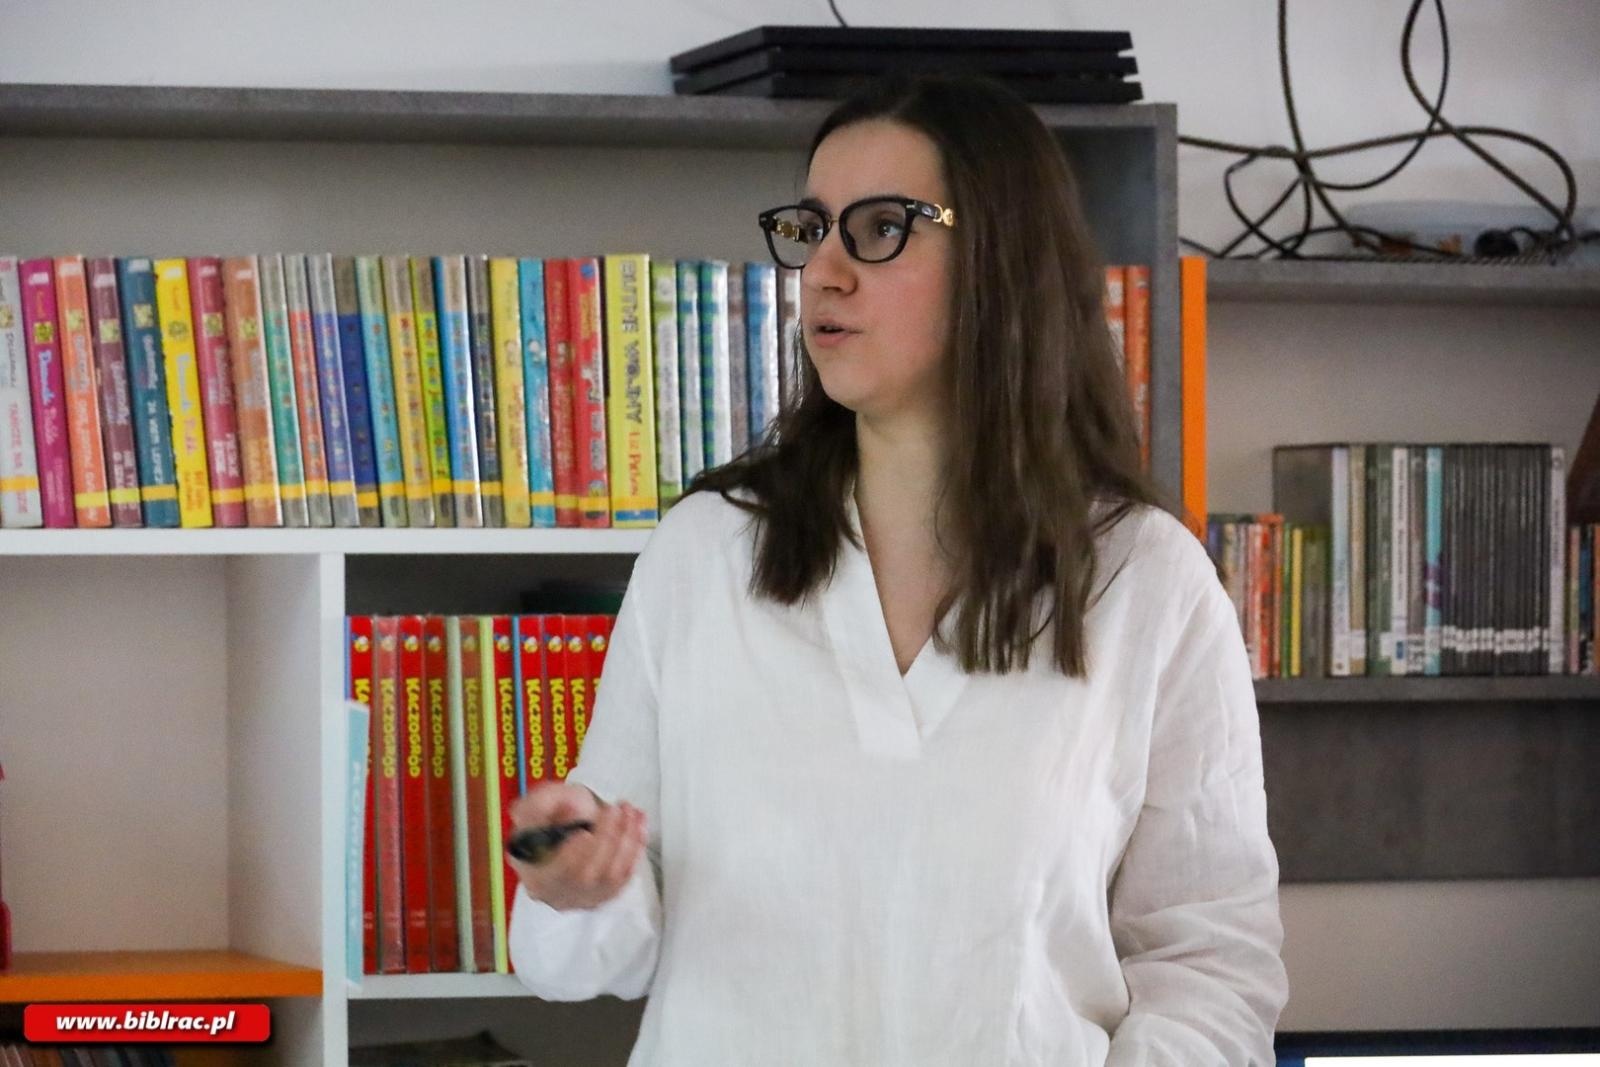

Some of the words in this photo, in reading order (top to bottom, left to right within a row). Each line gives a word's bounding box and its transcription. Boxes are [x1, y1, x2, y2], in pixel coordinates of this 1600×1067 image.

[380, 678, 398, 778] KACZOGRÓD
[405, 678, 422, 778] KACZOGRÓD
[429, 678, 445, 778] KACZOGRÓD
[498, 678, 516, 778] KACZOGRÓD
[526, 678, 544, 778] KACZOGRÓD
[550, 678, 568, 778] KACZOGRÓD
